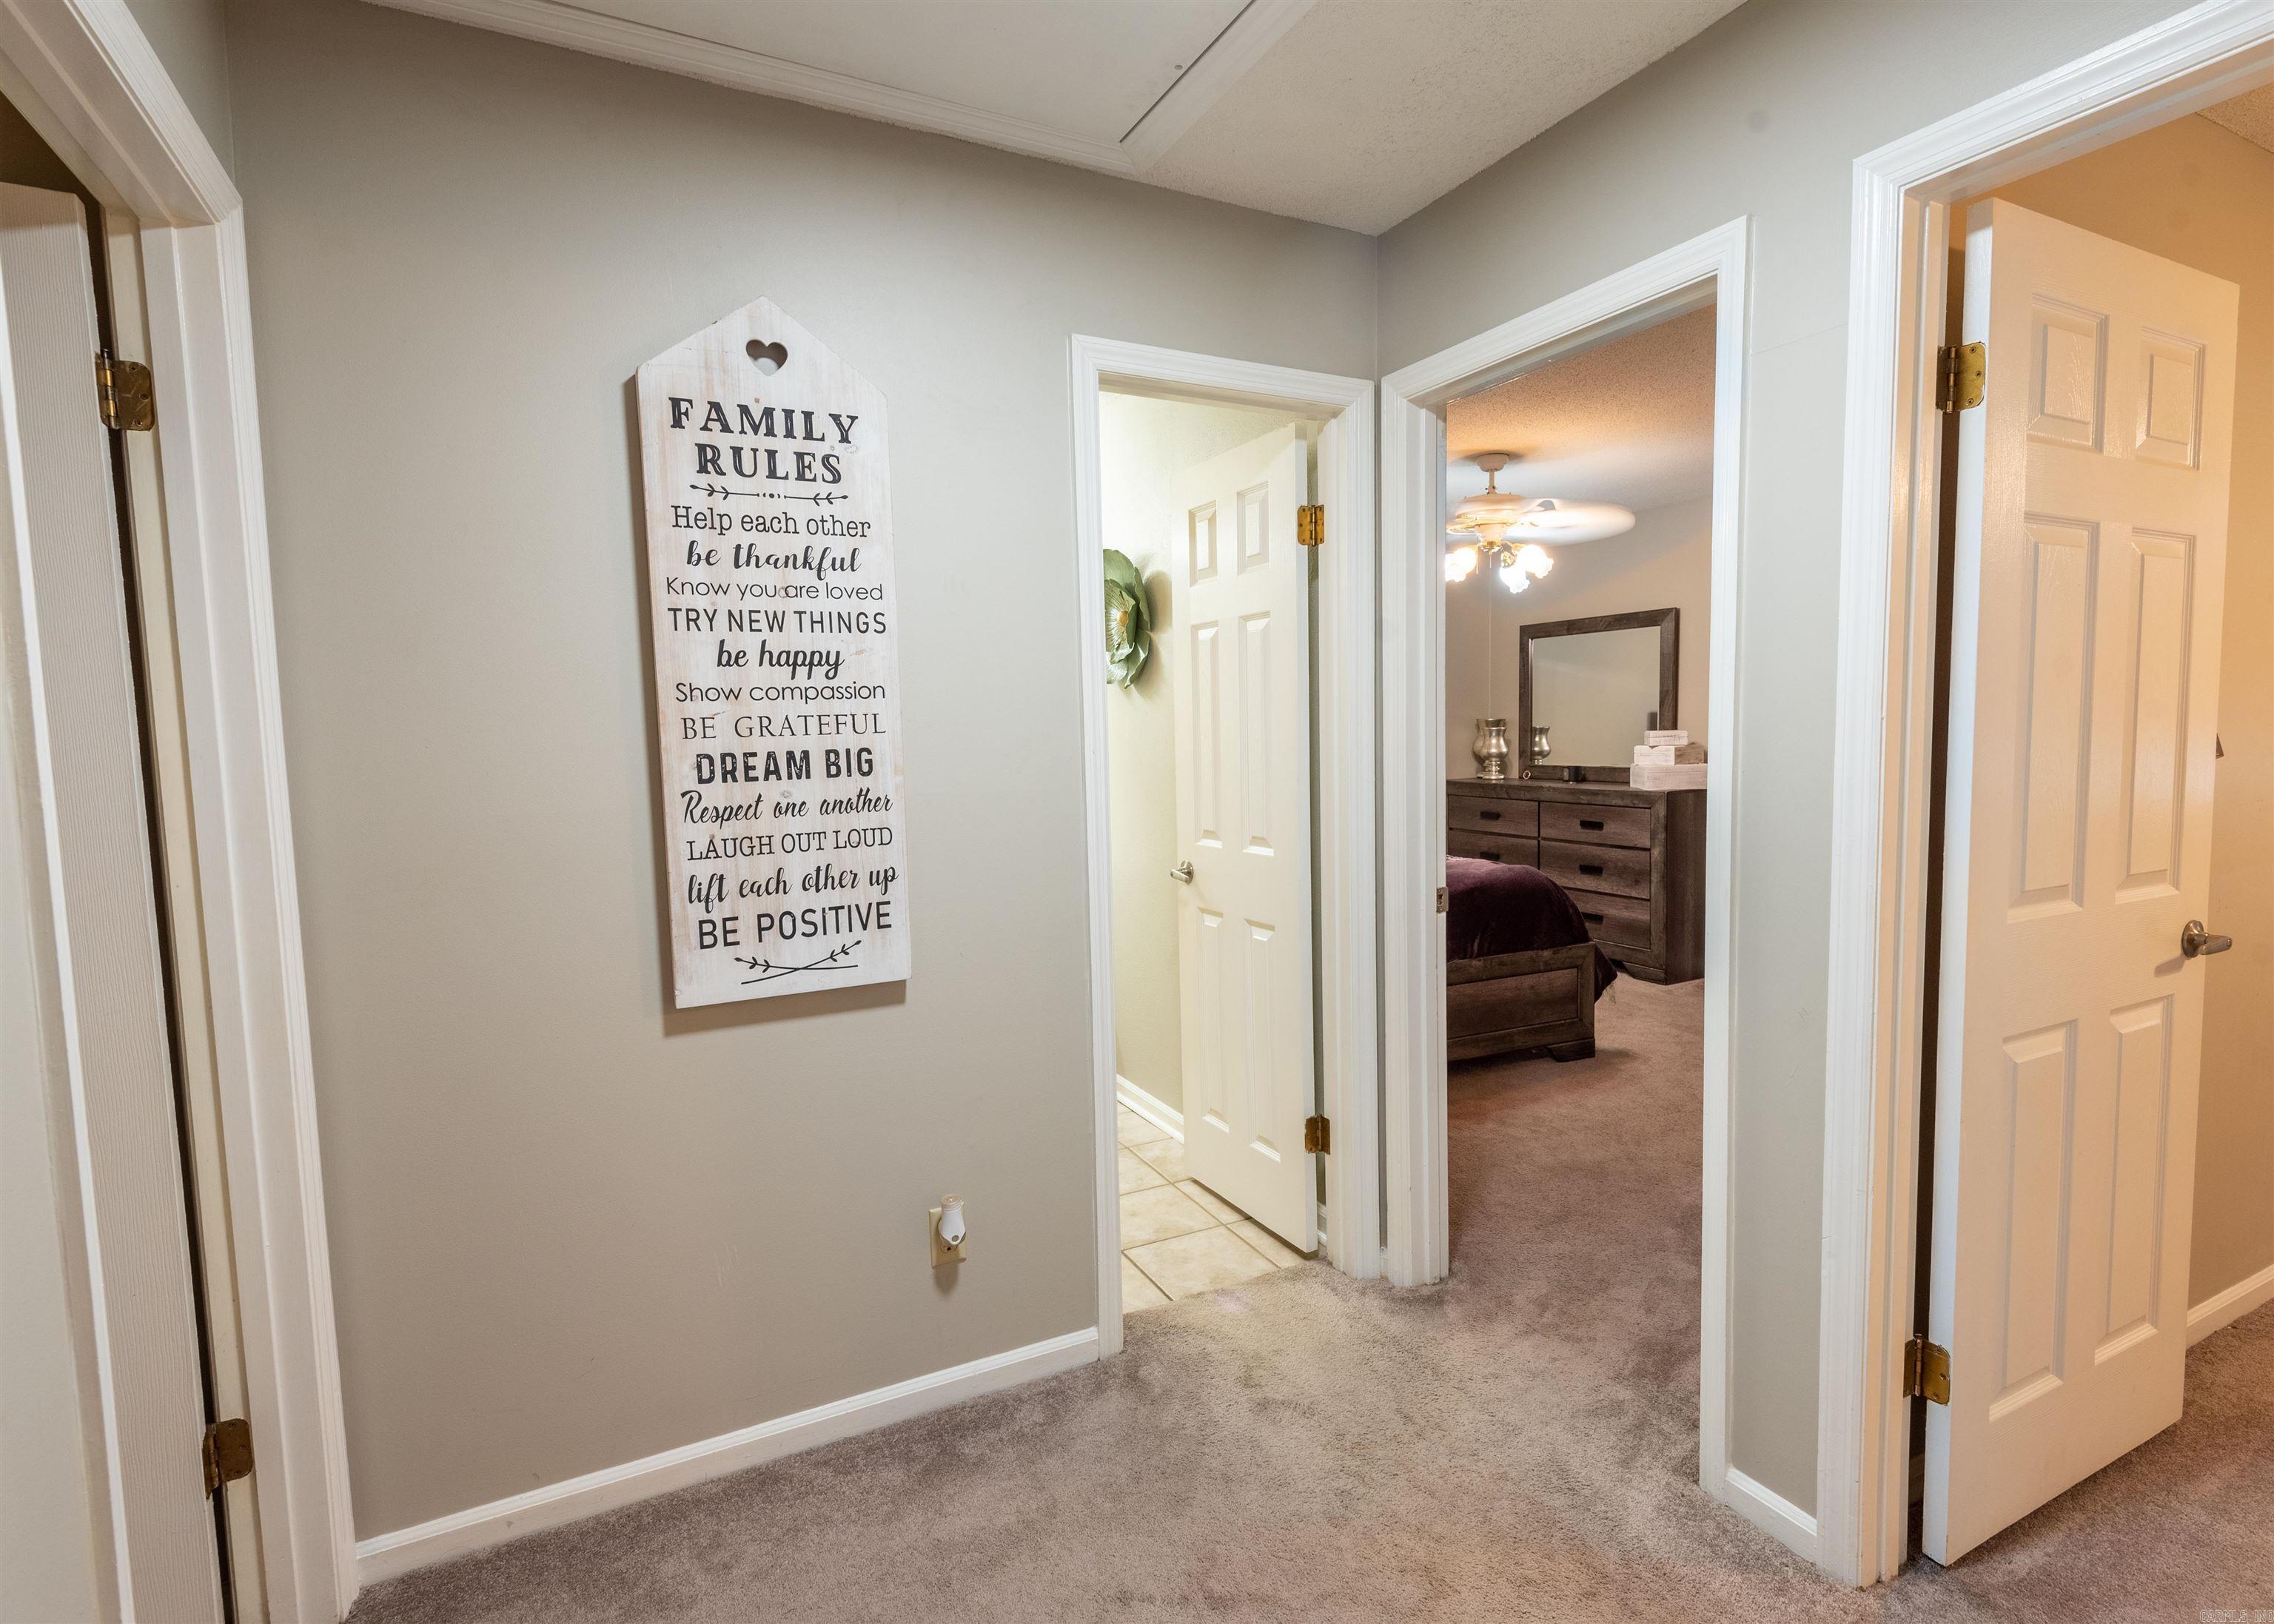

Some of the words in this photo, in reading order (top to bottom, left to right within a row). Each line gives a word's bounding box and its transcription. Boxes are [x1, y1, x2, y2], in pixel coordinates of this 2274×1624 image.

[668, 397, 859, 444] FAMILY
[695, 443, 842, 484] RULES
[671, 506, 732, 535] Help
[741, 511, 799, 534] each
[806, 514, 871, 537] other
[686, 540, 721, 566] be
[733, 543, 862, 580] thankful
[667, 577, 730, 596] Know
[737, 583, 777, 600] you
[784, 584, 819, 598] are
[826, 583, 882, 600] loved
[668, 608, 718, 631] TRY
[728, 608, 785, 632] NEW
[794, 611, 887, 634] THINGS
[717, 639, 748, 668] be
[759, 640, 845, 680] happy
[676, 682, 742, 702] Show
[749, 680, 885, 705] compassion
[681, 717, 717, 739] BE
[734, 713, 886, 738] GRATEFUL
[696, 750, 811, 784] DREAM
[825, 747, 873, 779] BIG
[680, 790, 762, 829] Respect
[774, 798, 809, 819] one
[819, 787, 893, 815] another
[686, 835, 775, 861] LAUGH
[781, 831, 827, 853] OUT
[833, 827, 893, 849] LOUD
[688, 873, 729, 913] lift
[739, 868, 793, 899] each
[802, 863, 860, 891] other
[870, 866, 899, 895] up
[698, 916, 740, 950] BE
[757, 901, 892, 943] POSITIVE
